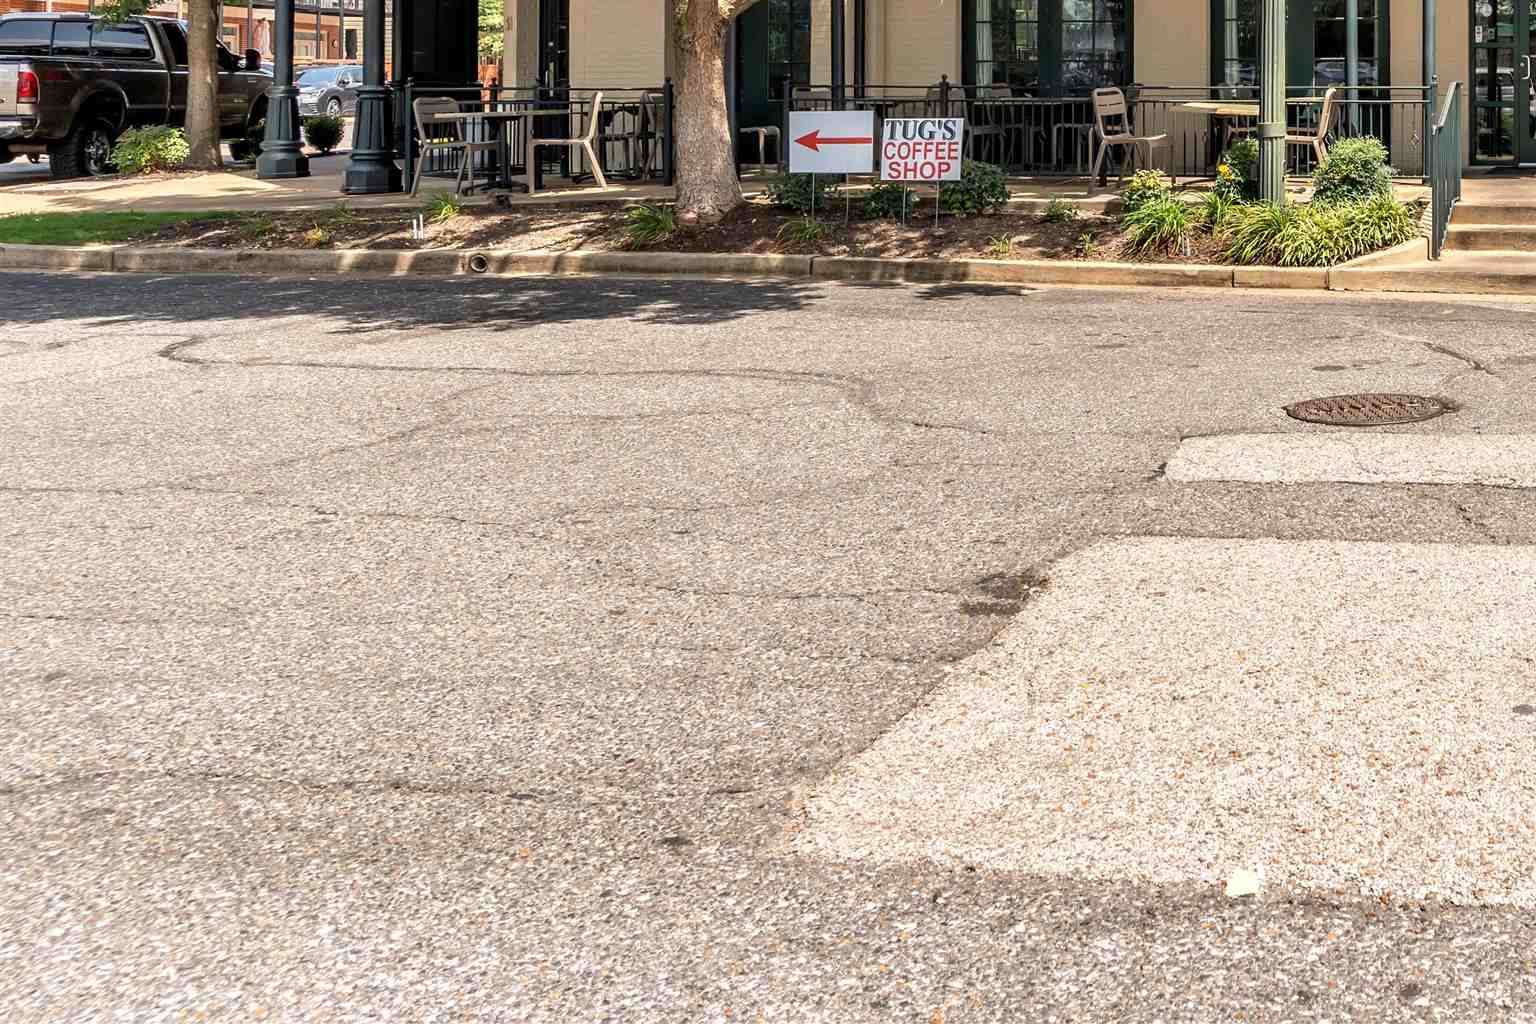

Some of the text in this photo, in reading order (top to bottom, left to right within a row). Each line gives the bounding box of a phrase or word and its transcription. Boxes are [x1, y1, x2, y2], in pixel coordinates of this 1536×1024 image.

[886, 119, 957, 141] TUG'S
[884, 141, 960, 160] COFFEE
[888, 161, 951, 179] SHOP
